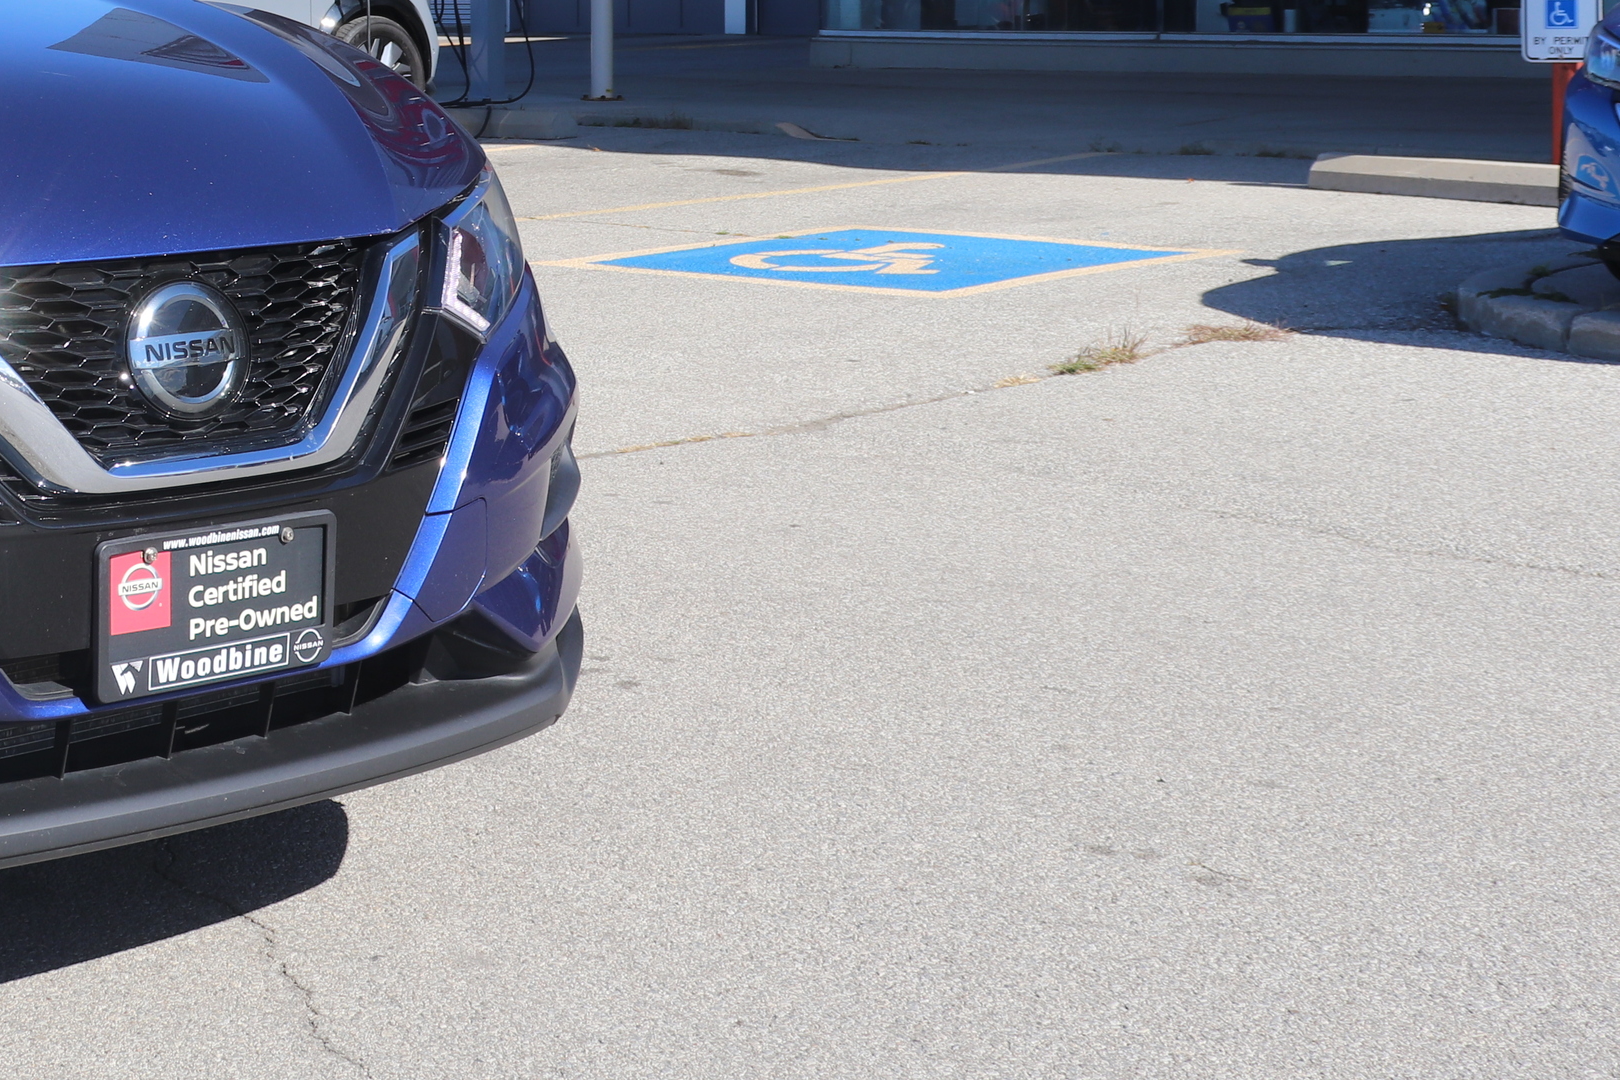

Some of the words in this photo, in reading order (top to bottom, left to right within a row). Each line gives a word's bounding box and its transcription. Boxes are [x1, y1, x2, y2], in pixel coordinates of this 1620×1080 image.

[1533, 36, 1547, 45] BY
[1554, 36, 1589, 45] PERMIT
[1549, 46, 1575, 55] ONLY
[145, 335, 236, 363] NISSAN
[163, 524, 280, 551] www.woodbinenissan.com
[188, 547, 267, 577] Nissan
[121, 580, 159, 594] NISSAN
[188, 570, 287, 608] Certified
[188, 595, 318, 641] Pre-Owned
[293, 638, 324, 652] NISSAN
[156, 643, 284, 684] Woodbine
